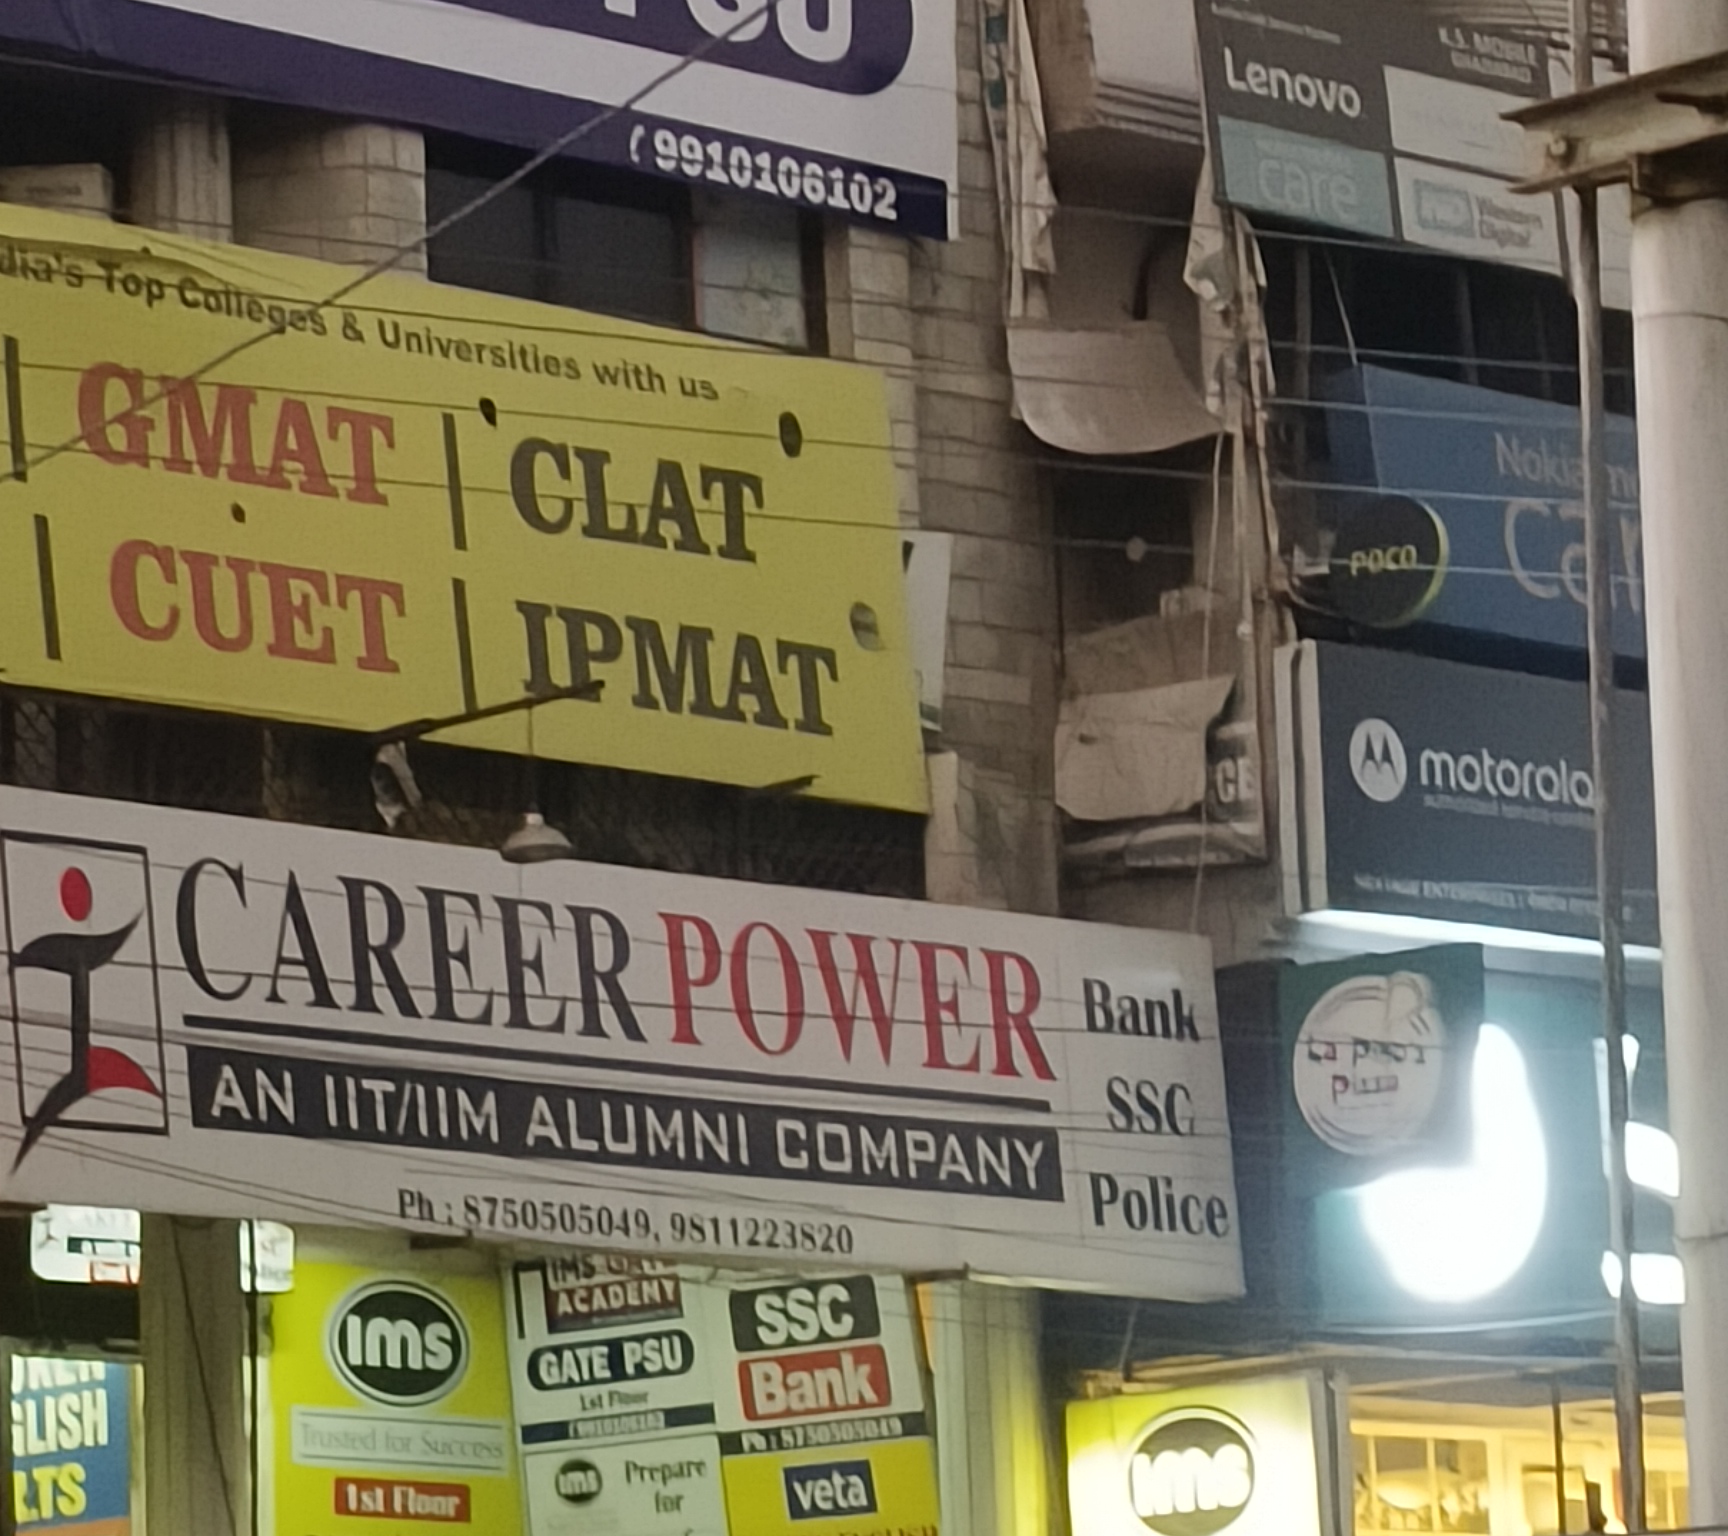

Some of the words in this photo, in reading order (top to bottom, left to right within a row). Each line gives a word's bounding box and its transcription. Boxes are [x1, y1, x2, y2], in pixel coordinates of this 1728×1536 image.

[1223, 47, 1361, 118] Lenovo
[654, 122, 899, 222] 9910106102
[100, 260, 166, 308] Top
[178, 279, 329, 338] Colleges
[341, 310, 367, 345] &
[377, 318, 582, 383] Universities
[592, 357, 667, 398] with
[678, 373, 720, 404] us
[77, 361, 396, 507] GMAT
[509, 437, 764, 564] CLAT
[109, 539, 406, 674] CUET
[514, 600, 838, 737] IPMAT
[1420, 748, 1598, 809] motorola
[175, 856, 648, 1044] CAREER
[657, 910, 1057, 1081] POWER
[1082, 977, 1200, 1043] Bank
[210, 1063, 295, 1126] AN
[324, 1072, 500, 1143] IIT/IIM
[525, 1094, 749, 1167] ALUMNI
[776, 1117, 1044, 1190] COMPANY
[670, 1212, 854, 1255] 9811223820
[1088, 1171, 1231, 1238] Police
[346, 1314, 453, 1371] ims
[754, 1283, 854, 1345] SSC
[538, 1345, 611, 1385] GATE
[623, 1335, 683, 1376] PSU
[749, 1352, 880, 1416] Bank
[347, 1483, 384, 1513] 1st
[625, 1458, 707, 1489] Prepare
[654, 1492, 683, 1513] for
[793, 1469, 868, 1511] veta
